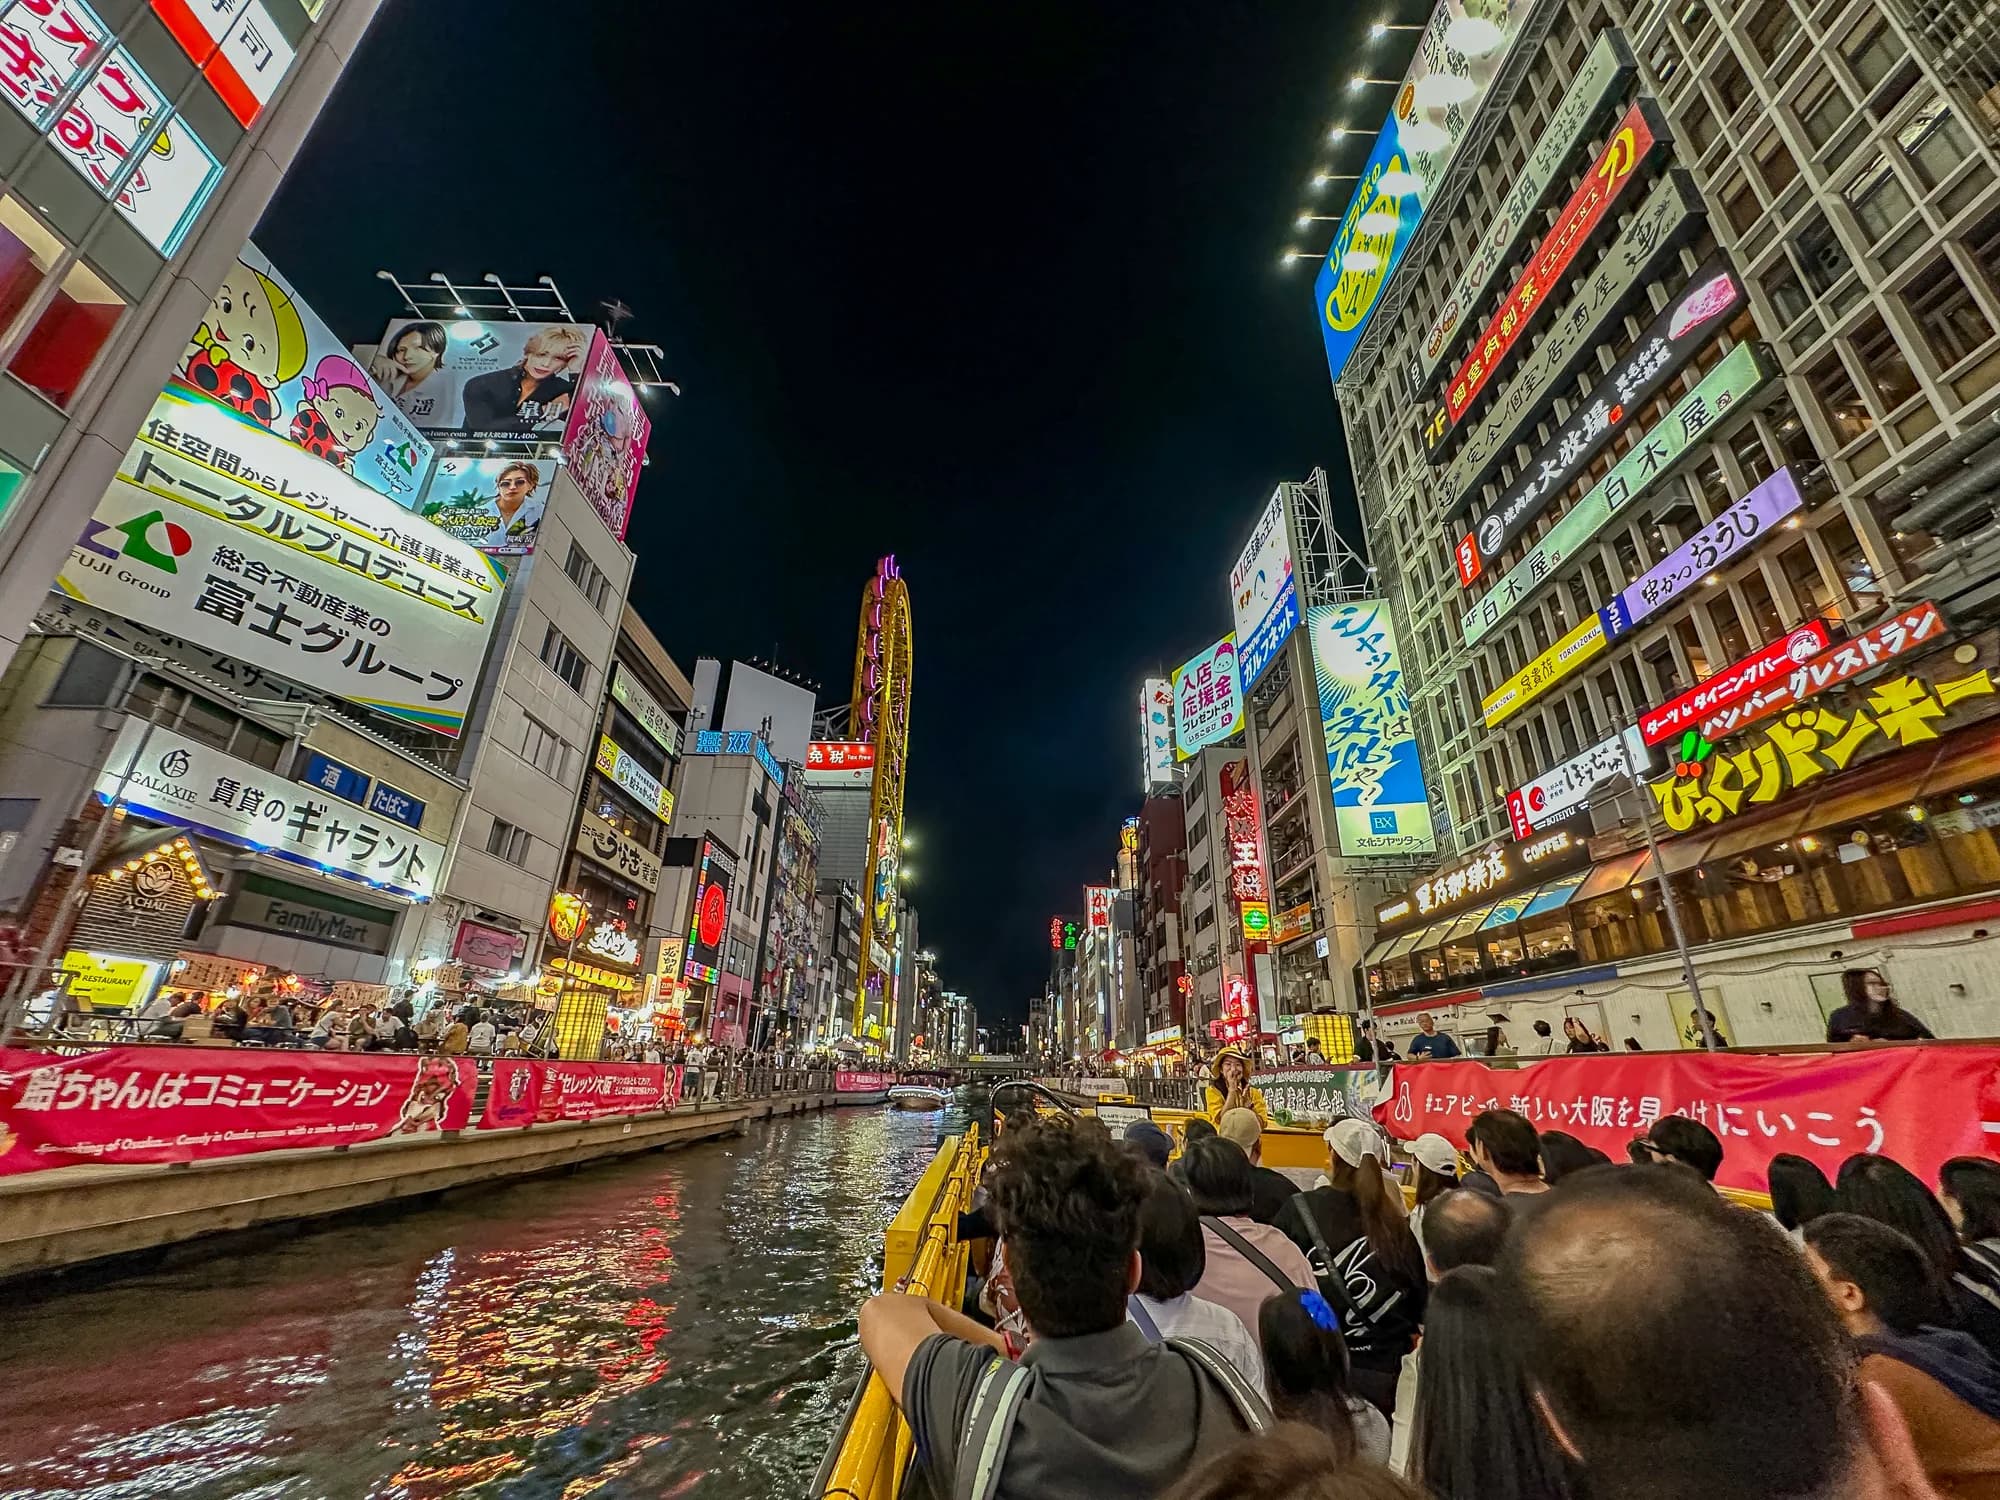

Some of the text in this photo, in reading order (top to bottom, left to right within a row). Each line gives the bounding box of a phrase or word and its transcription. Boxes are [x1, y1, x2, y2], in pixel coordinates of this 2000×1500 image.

[1424, 406, 1447, 450] 7F
[1464, 394, 1717, 630] 4F 白木屋 白木屋
[134, 449, 482, 620] トータルプロデュース
[1458, 543, 1474, 580] 5F
[117, 570, 171, 599] Group
[211, 544, 392, 639] 総合不動産業の
[192, 573, 464, 703] 富士グループ
[1605, 603, 1625, 636] 3F
[1180, 661, 1213, 698] 入店
[1519, 656, 1556, 697] 鳥貴族
[1702, 610, 1937, 736] ハンバーグレストラン
[1182, 674, 1232, 721] 応援金
[807, 748, 845, 765] 免税
[858, 753, 872, 762] free
[1651, 668, 1996, 832] びっくりドンキー
[322, 763, 341, 791] 酒
[371, 787, 411, 821] たばこ
[1373, 816, 1394, 830] BX
[1512, 799, 1528, 838] 2F
[208, 776, 427, 882] 賃貸のギャラント
[263, 901, 370, 942] FamilyMart
[81, 974, 133, 986] RESTAURANT
[12, 1065, 392, 1112] 飴ちゃんはコミュニケーション
